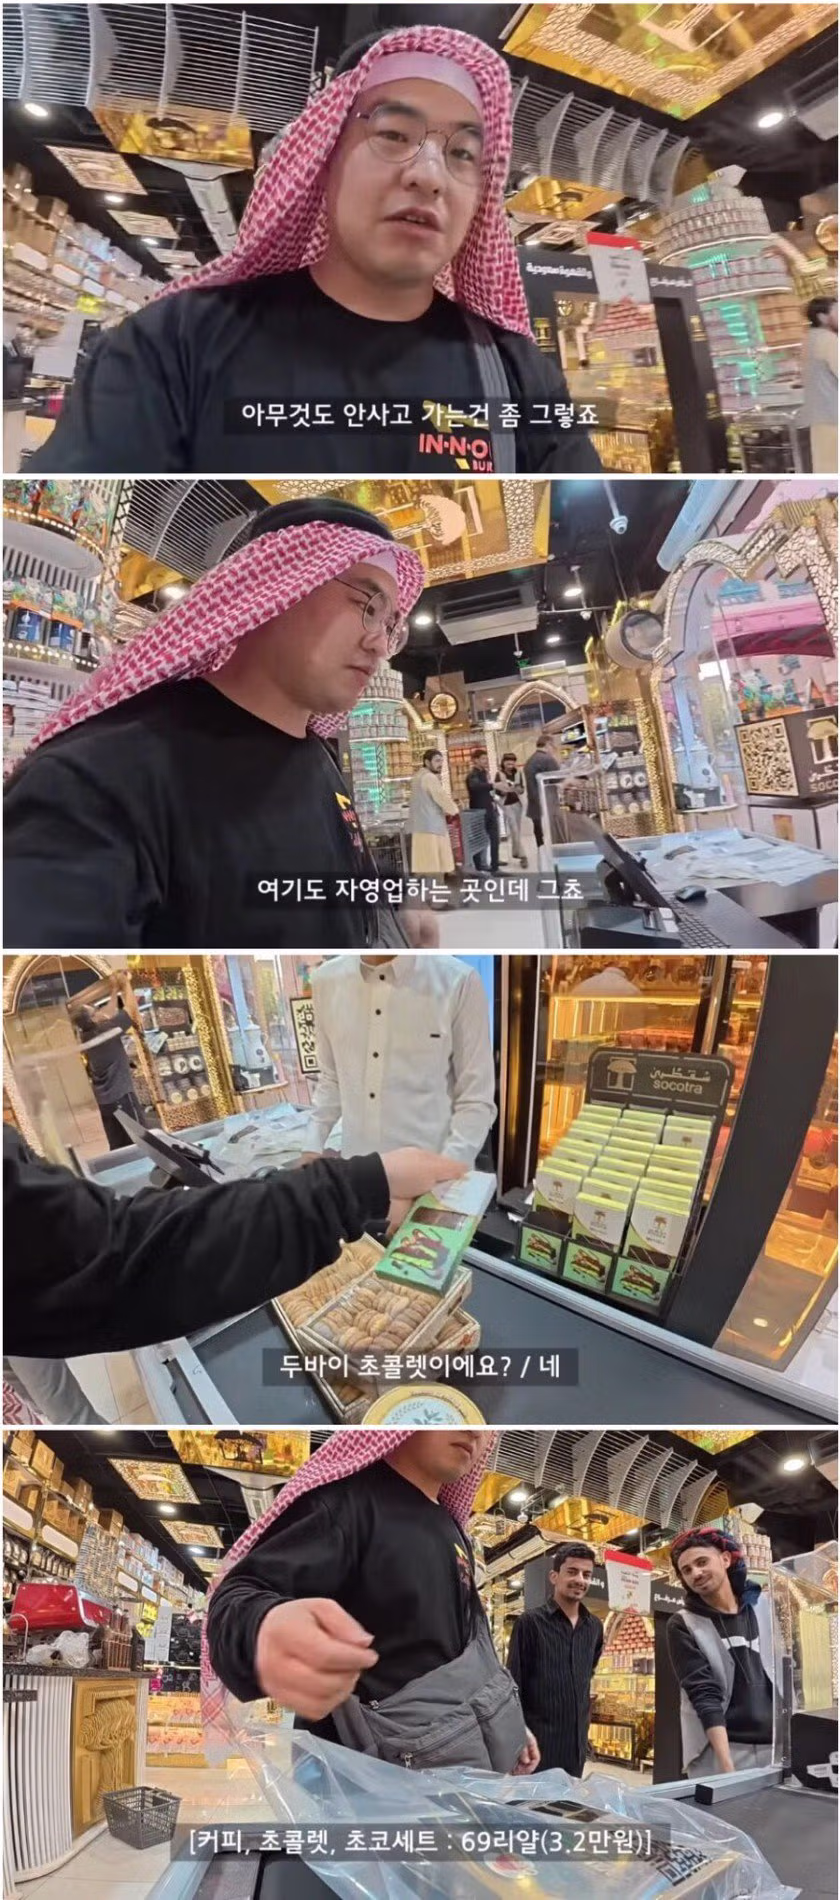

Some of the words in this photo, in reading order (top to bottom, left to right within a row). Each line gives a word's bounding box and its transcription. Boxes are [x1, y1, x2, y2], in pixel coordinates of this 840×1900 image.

[418, 432, 492, 460] IN-N-O
[472, 459, 493, 473] BUR
[652, 1079, 703, 1095] socotra
